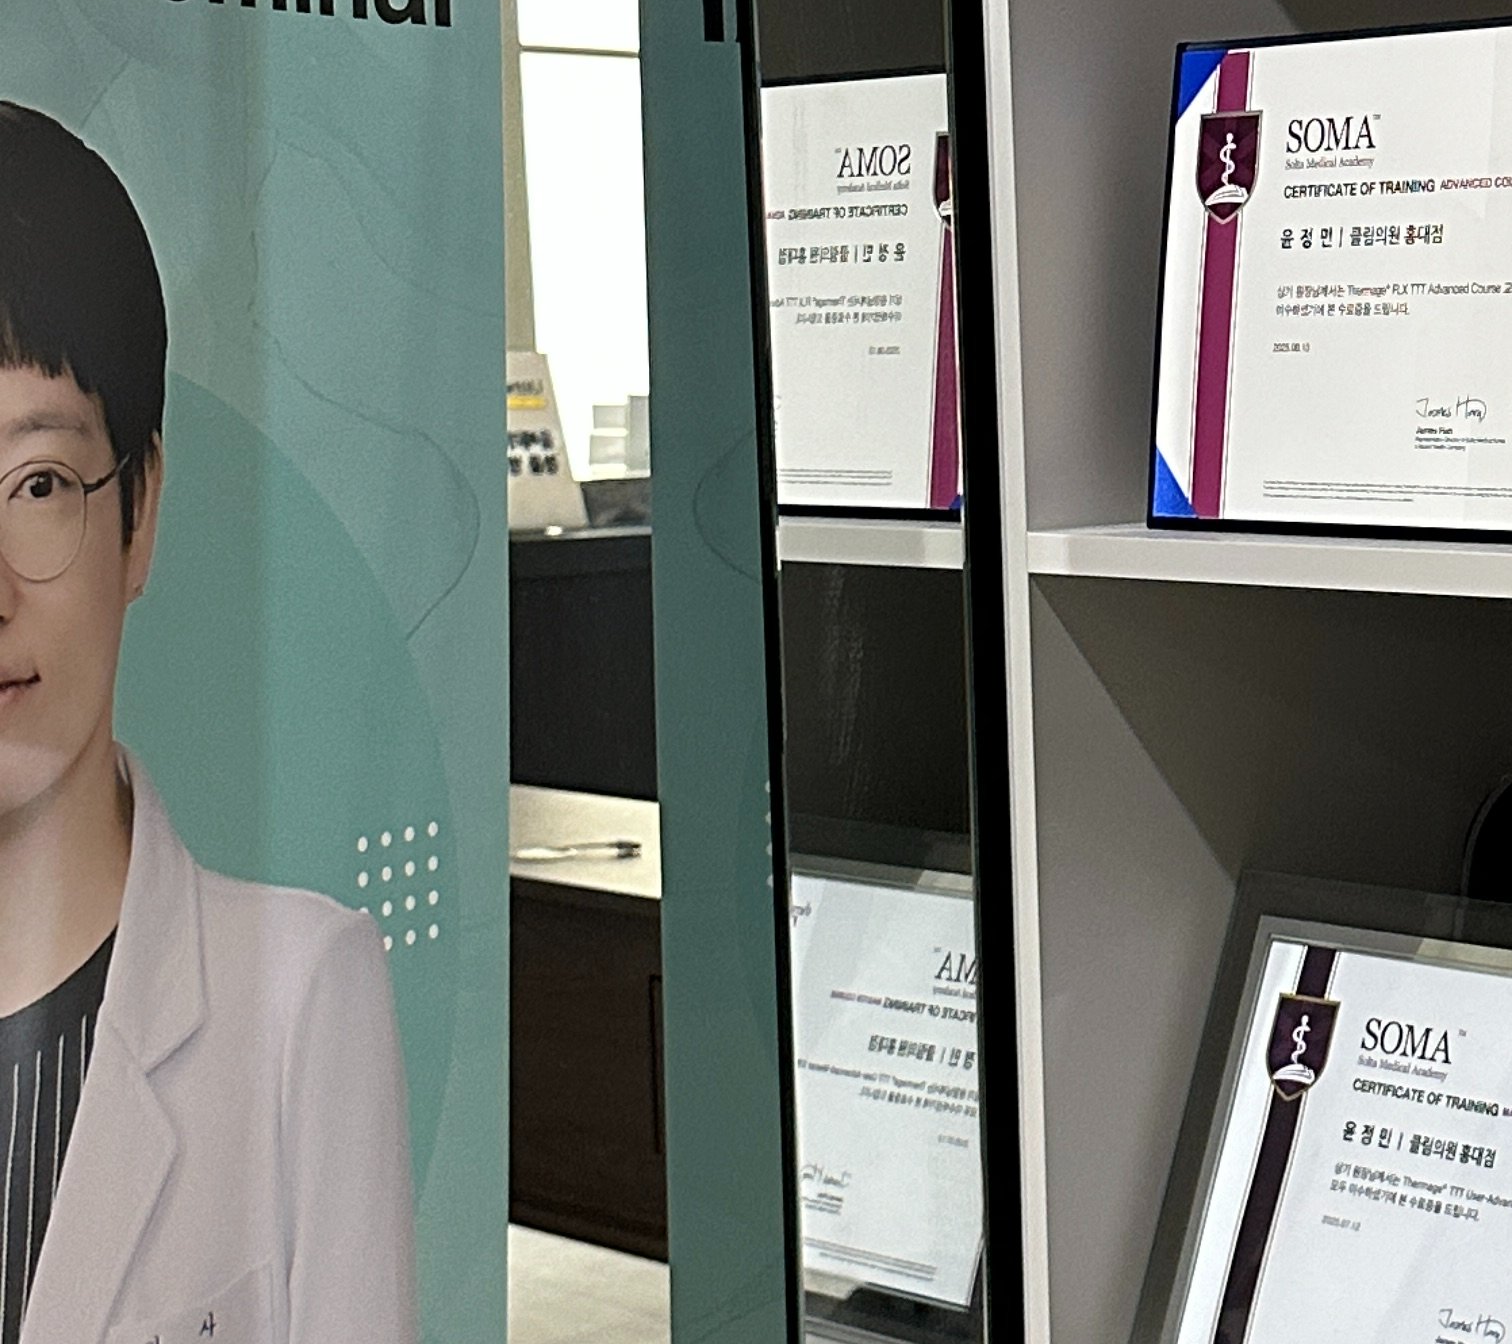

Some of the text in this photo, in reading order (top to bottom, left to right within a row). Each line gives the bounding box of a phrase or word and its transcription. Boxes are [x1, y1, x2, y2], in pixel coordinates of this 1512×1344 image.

[1286, 114, 1378, 154] SOMA
[1283, 181, 1358, 200] CERTIFICATE
[1360, 180, 1378, 196] OF
[1379, 178, 1436, 196] TRAINING
[1440, 176, 1493, 191] ADVANCED
[1360, 1017, 1452, 1065] SOMA
[1352, 1077, 1425, 1104] CERTIFICATE
[1426, 1091, 1444, 1106] OF
[1445, 1094, 1499, 1118] TRAINING
